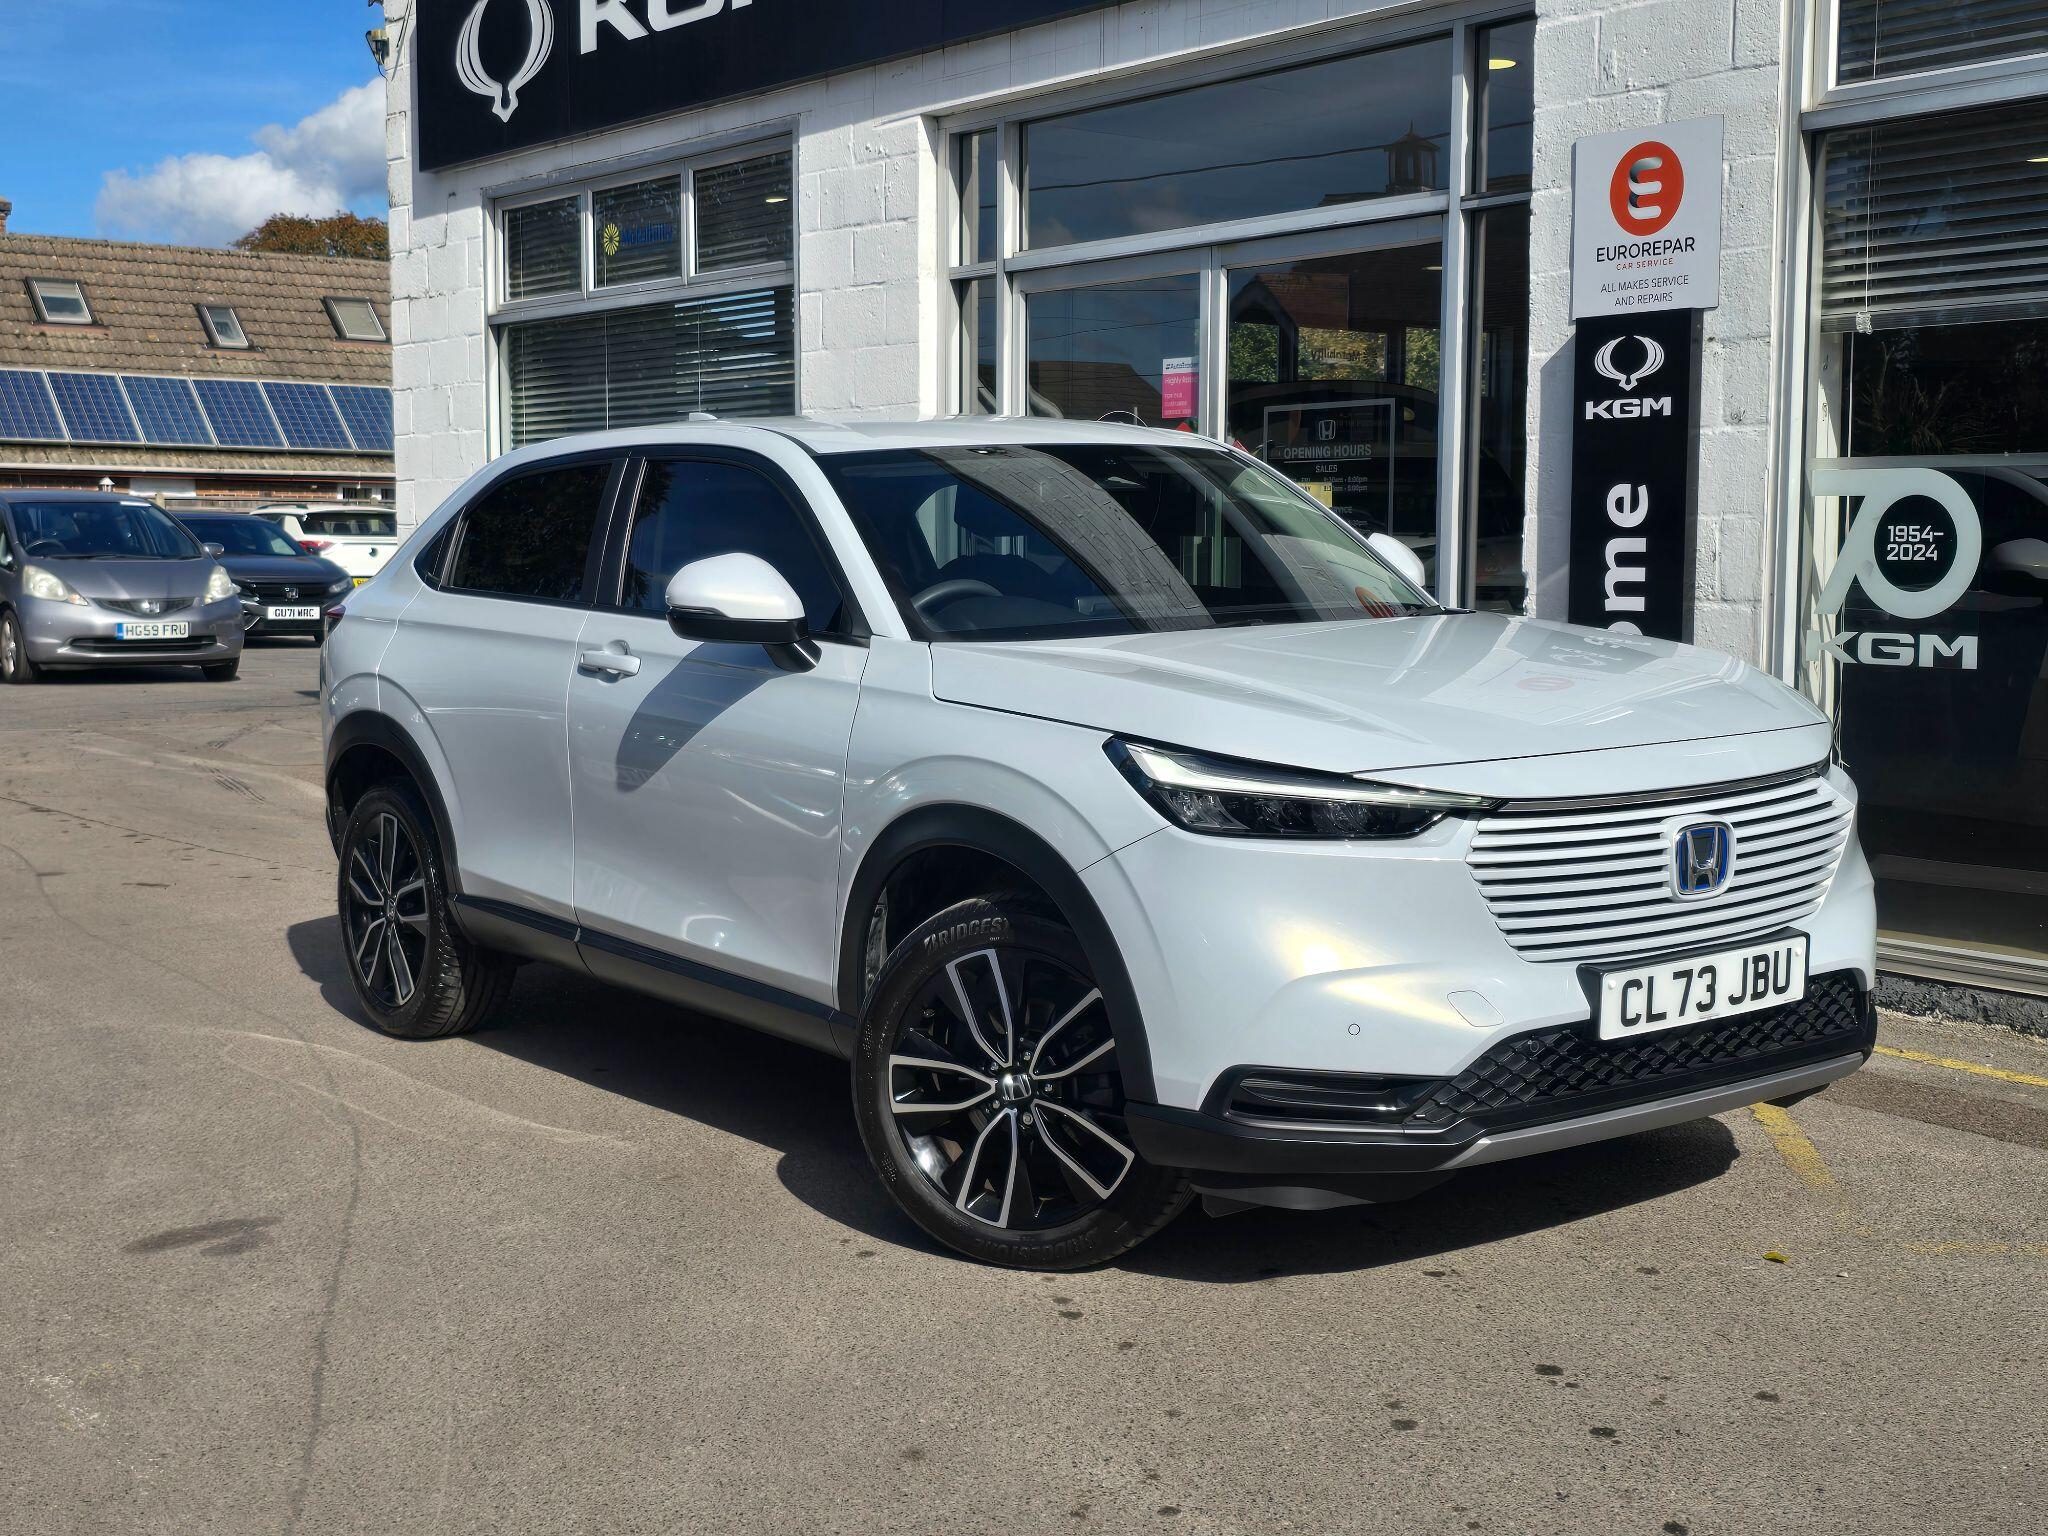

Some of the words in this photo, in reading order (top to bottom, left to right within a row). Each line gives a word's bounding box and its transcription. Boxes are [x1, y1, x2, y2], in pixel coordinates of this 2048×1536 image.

[1596, 236, 1696, 263] EUROREPAR
[1616, 262, 1633, 271] CAR
[1636, 257, 1674, 269] SERVICE
[1600, 283, 1617, 293] ALL
[1618, 278, 1650, 292] MAKES
[1651, 274, 1689, 288] SERVICE
[1614, 295, 1635, 307] AND
[1637, 291, 1673, 305] REPAIRS
[1585, 396, 1672, 420] KGM
[1284, 446, 1331, 459] OPENING
[1333, 443, 1372, 457] HOURS
[1315, 464, 1338, 473] SALES
[1887, 525, 1944, 543] 1954-
[1886, 543, 1938, 561] 2024
[126, 624, 159, 636] HG59
[162, 624, 186, 635] FRU
[1805, 629, 1979, 670] KGM
[1620, 964, 1717, 1028] CL73
[1728, 948, 1792, 1006] JBU
